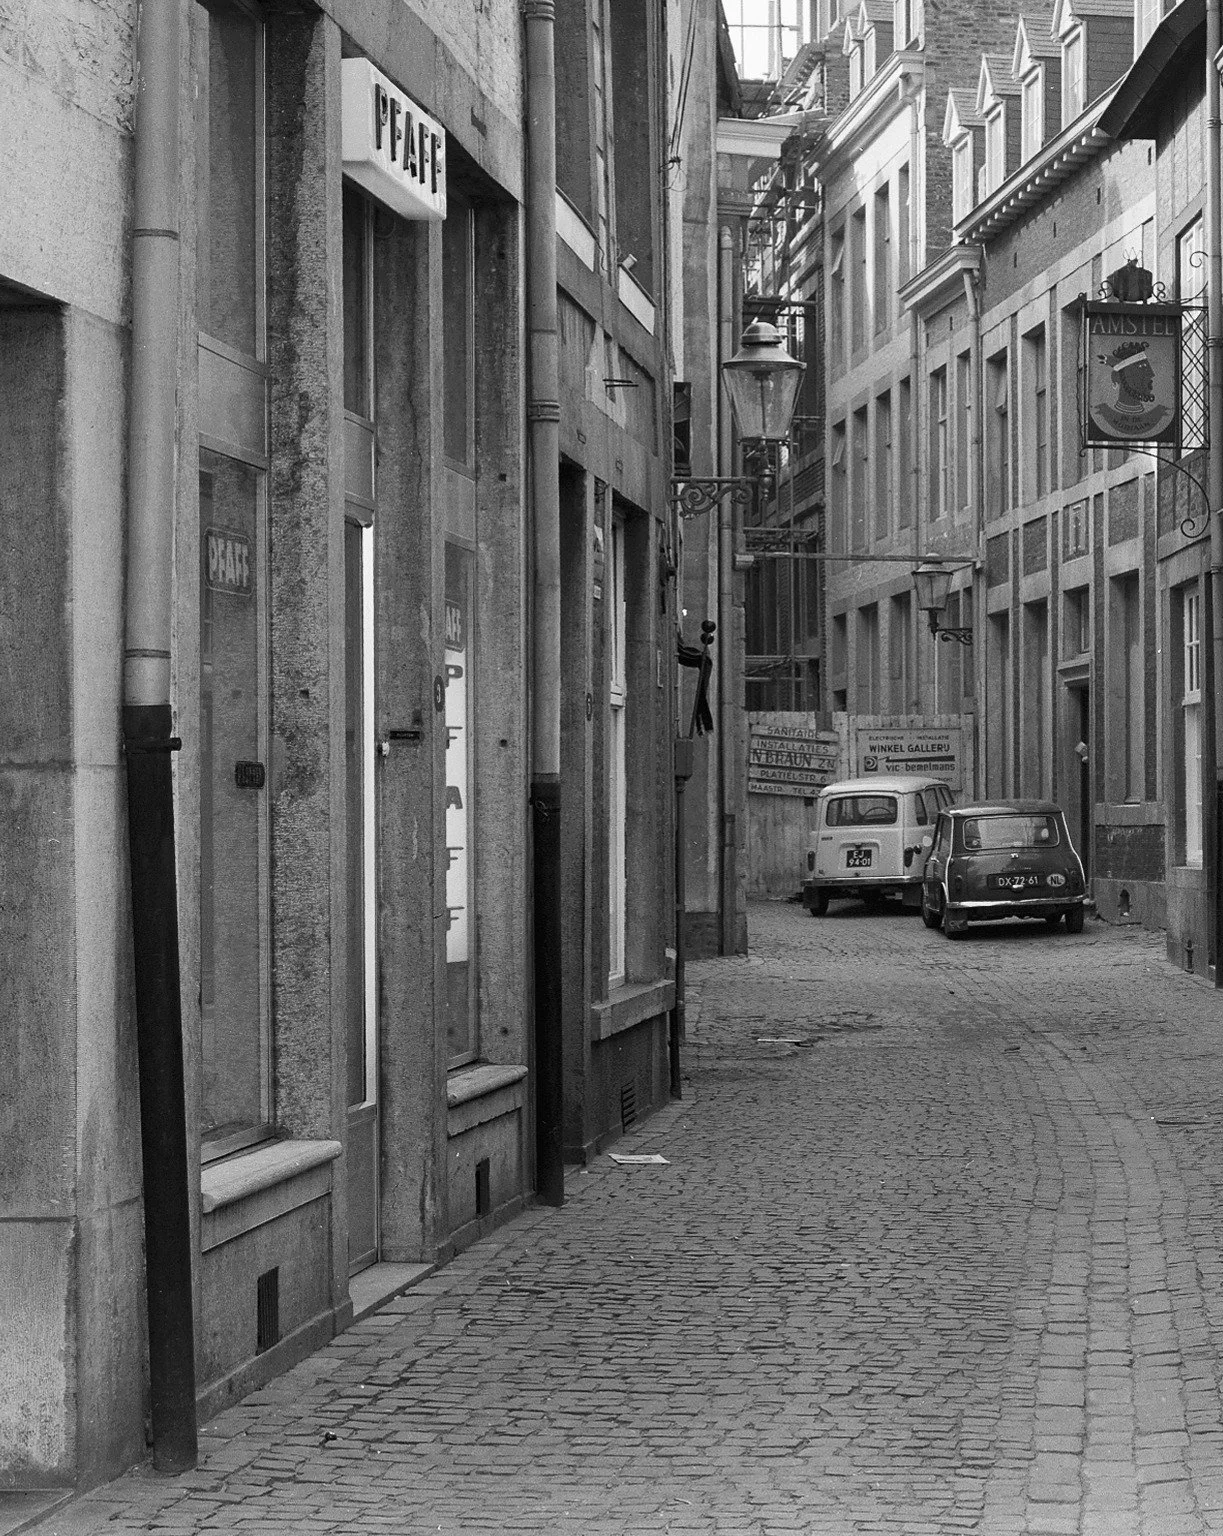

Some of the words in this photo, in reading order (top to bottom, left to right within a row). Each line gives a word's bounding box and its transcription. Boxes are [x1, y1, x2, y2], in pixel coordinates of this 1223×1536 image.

[374, 82, 442, 194] PFAFF
[1091, 314, 1174, 336] AMSTEL
[208, 535, 249, 588] PFAFF
[757, 739, 829, 755] INSTALLATIES
[869, 743, 905, 753] WINKEL
[765, 751, 812, 767] BRAUN
[853, 850, 865, 859] EJ
[998, 875, 1038, 886] DX-72-61
[1050, 875, 1062, 885] NL
